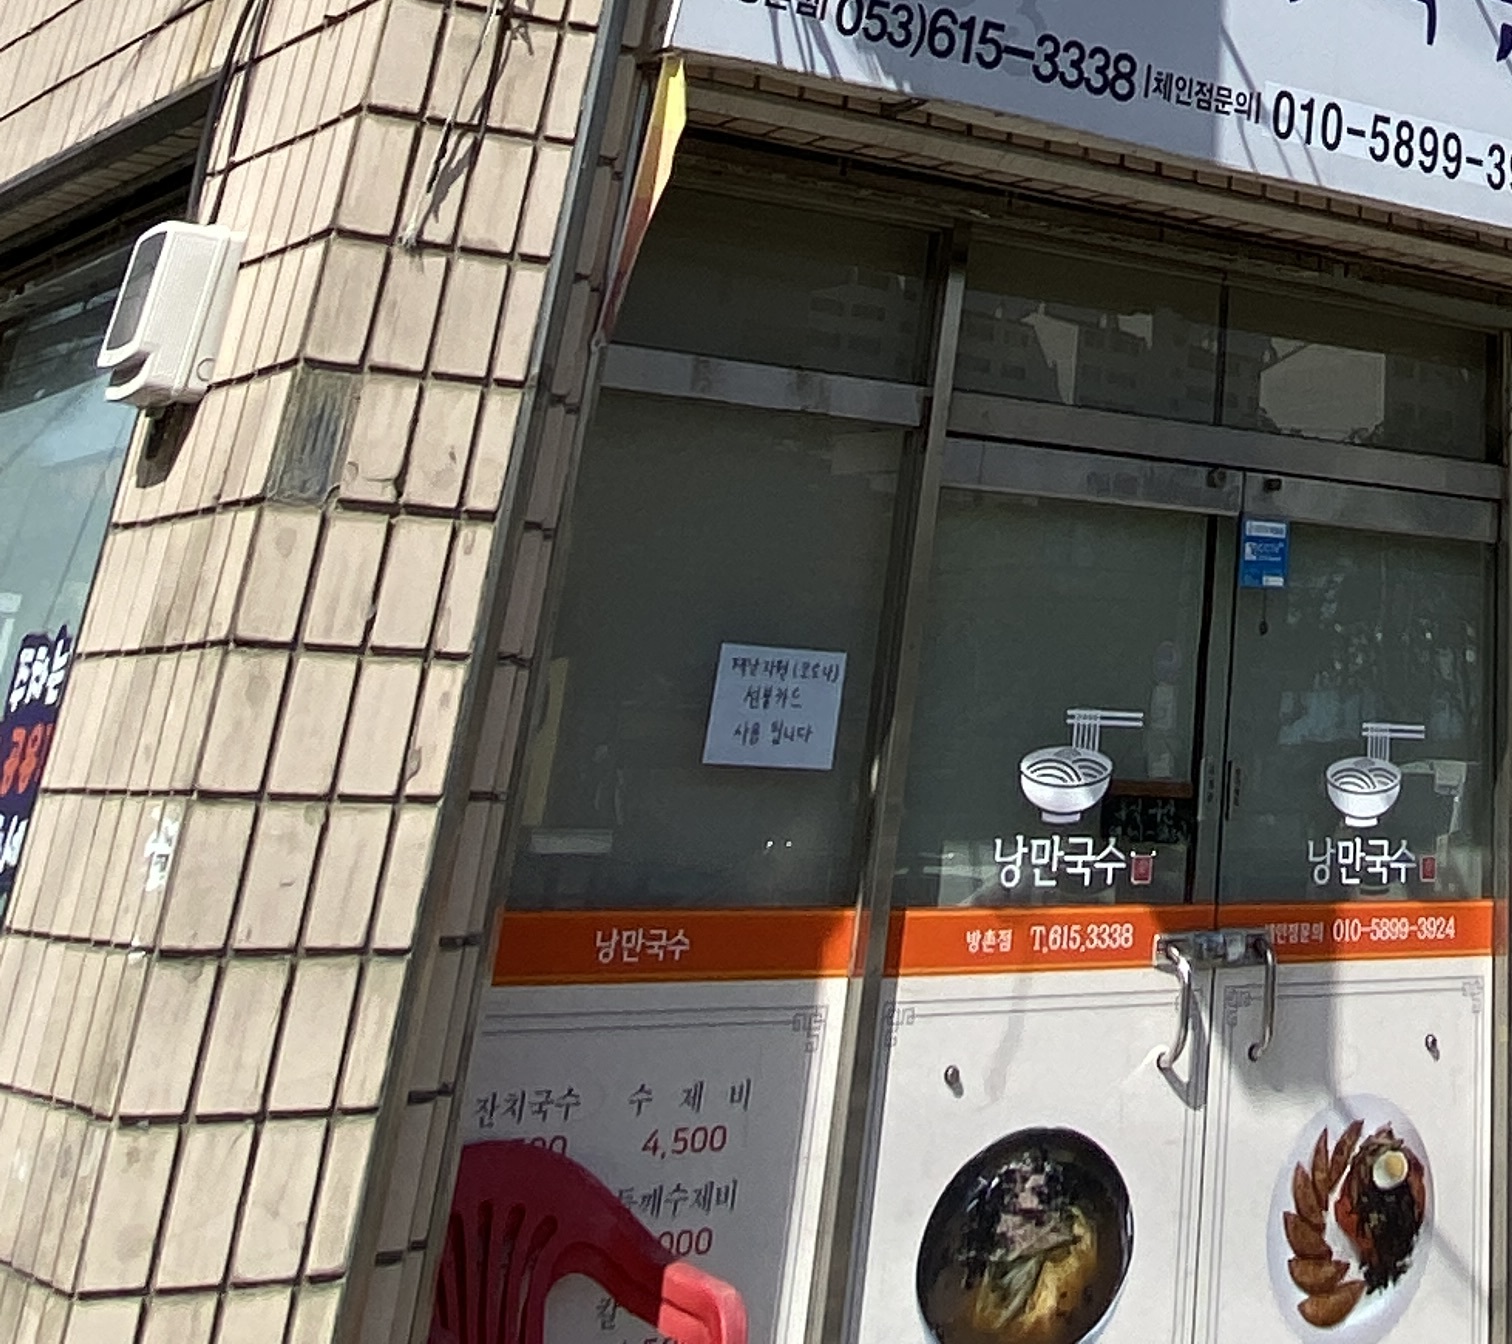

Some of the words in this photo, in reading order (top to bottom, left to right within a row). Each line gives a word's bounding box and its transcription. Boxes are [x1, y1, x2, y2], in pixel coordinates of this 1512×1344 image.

[994, 834, 1127, 888] 낭만국수
[1307, 836, 1417, 885] 낭만국수
[595, 927, 691, 964] 낭만국수
[966, 928, 1014, 953] 방촌점
[1332, 915, 1456, 943] 010-5899-3924
[475, 1085, 582, 1129] 잔치국수
[641, 1124, 728, 1160] 4,500
